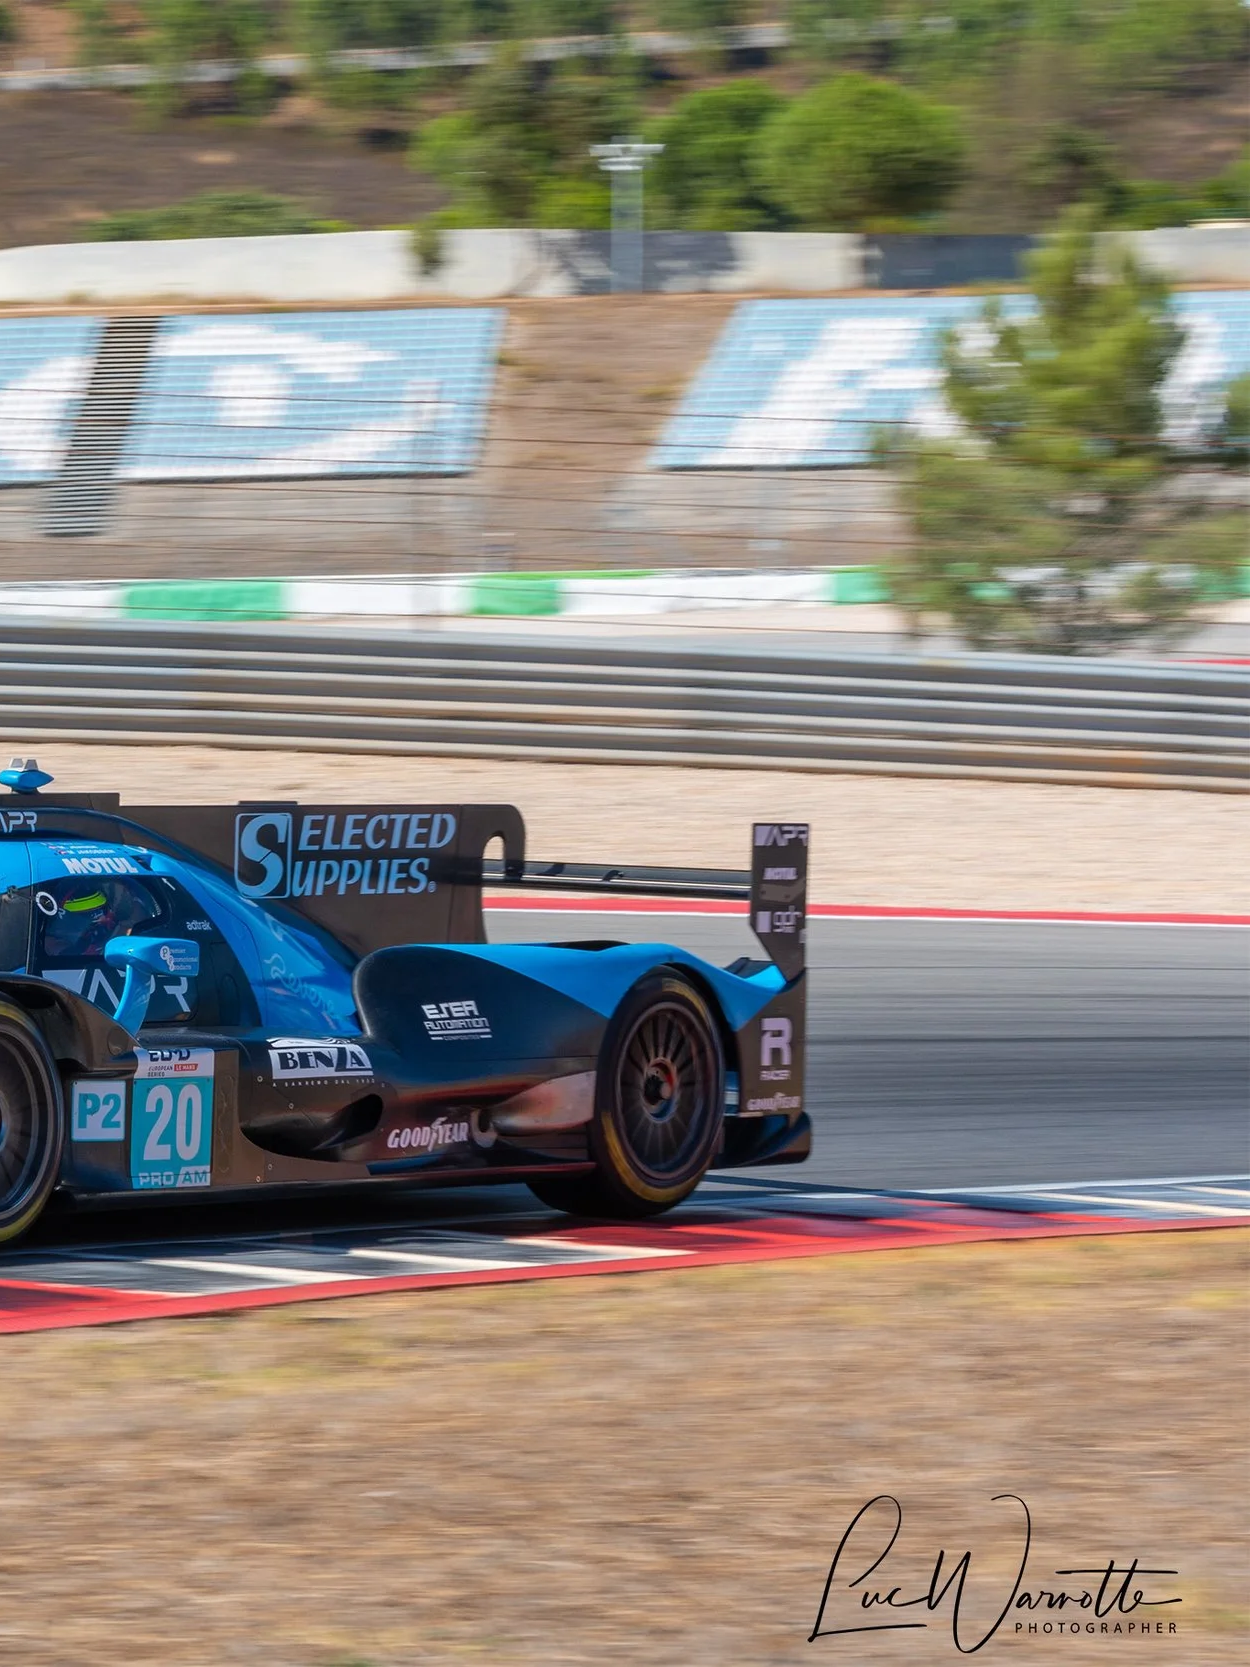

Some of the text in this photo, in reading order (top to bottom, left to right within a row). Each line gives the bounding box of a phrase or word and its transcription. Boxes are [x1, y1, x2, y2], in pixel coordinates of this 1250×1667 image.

[61, 857, 139, 874] MOTUL
[186, 919, 212, 931] adtrak
[78, 1093, 121, 1129] P2
[143, 1084, 202, 1161] 20
[387, 1117, 469, 1152] GOODYEAR
[138, 1170, 207, 1186] PRO AM
